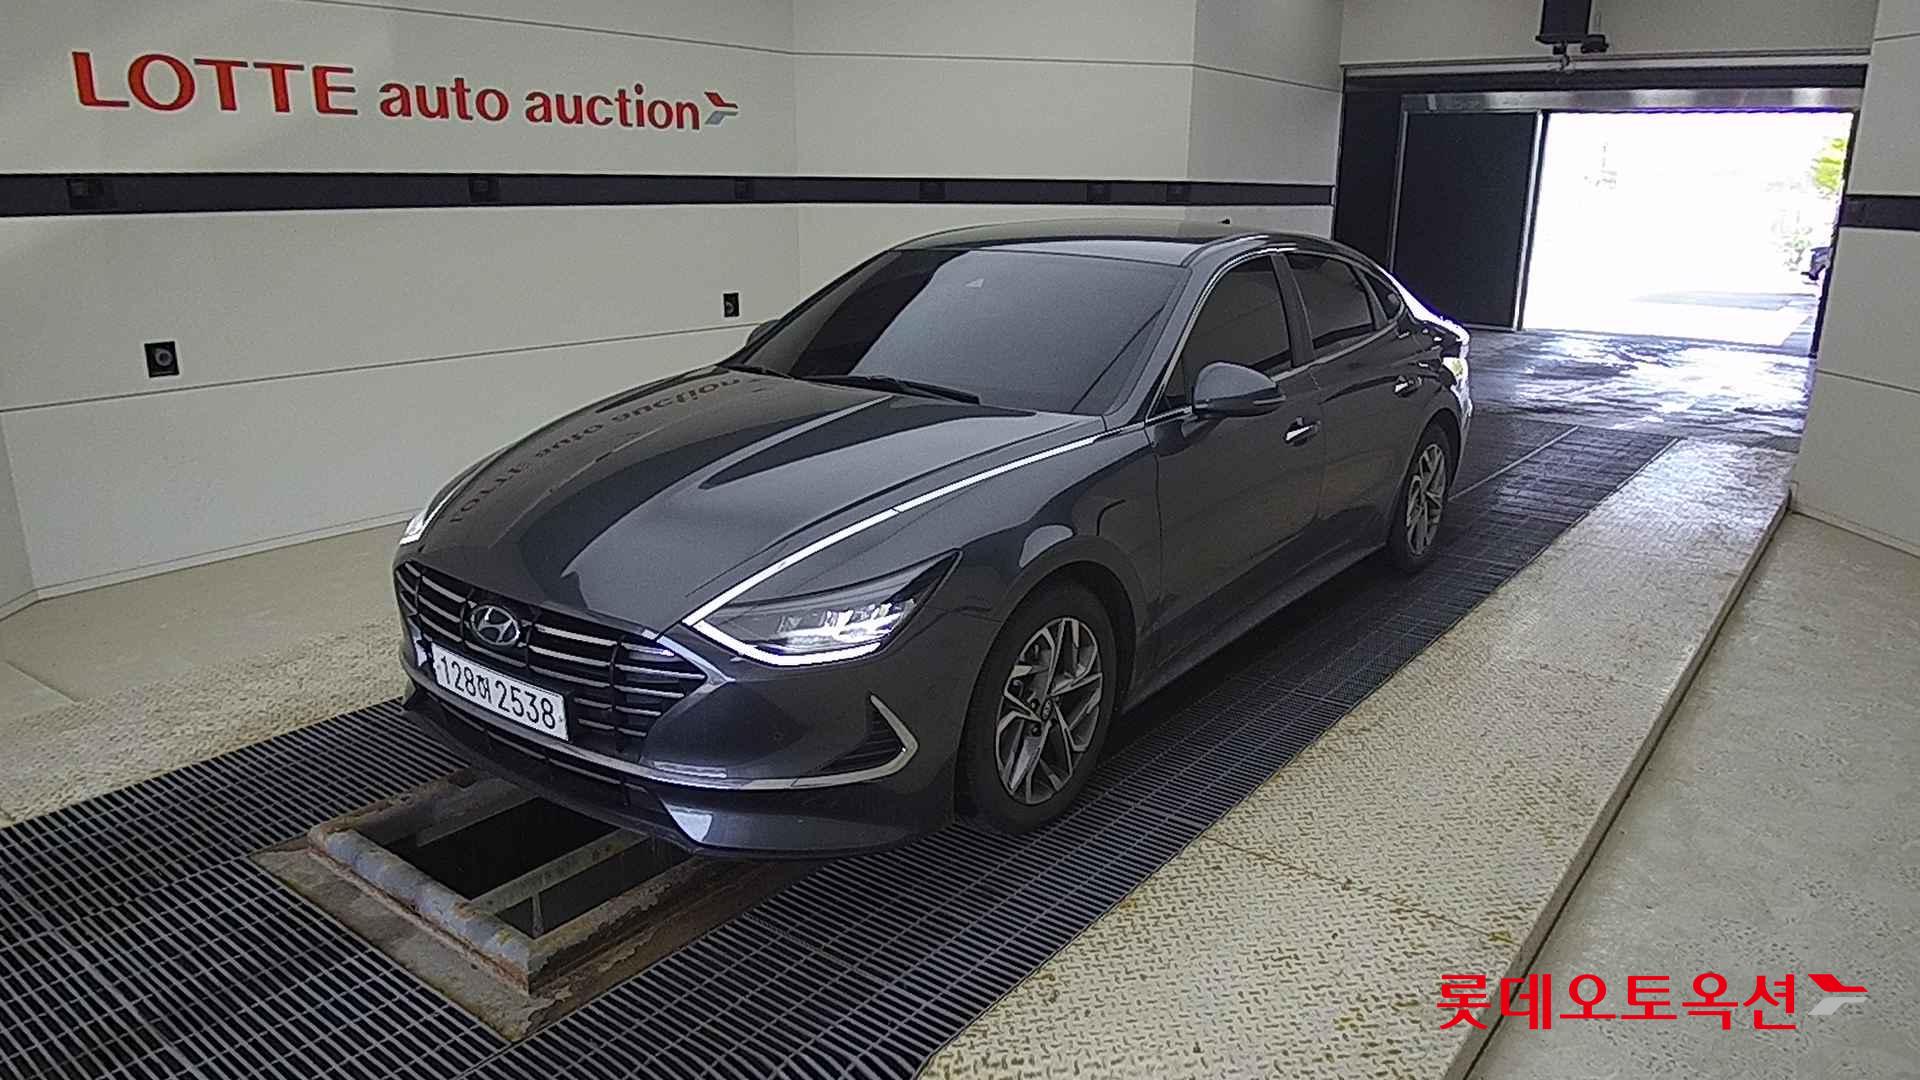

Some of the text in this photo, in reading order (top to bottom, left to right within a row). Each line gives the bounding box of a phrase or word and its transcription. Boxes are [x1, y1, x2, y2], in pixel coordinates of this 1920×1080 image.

[71, 51, 701, 131] LOTTE auto auction
[495, 680, 557, 730] 2538
